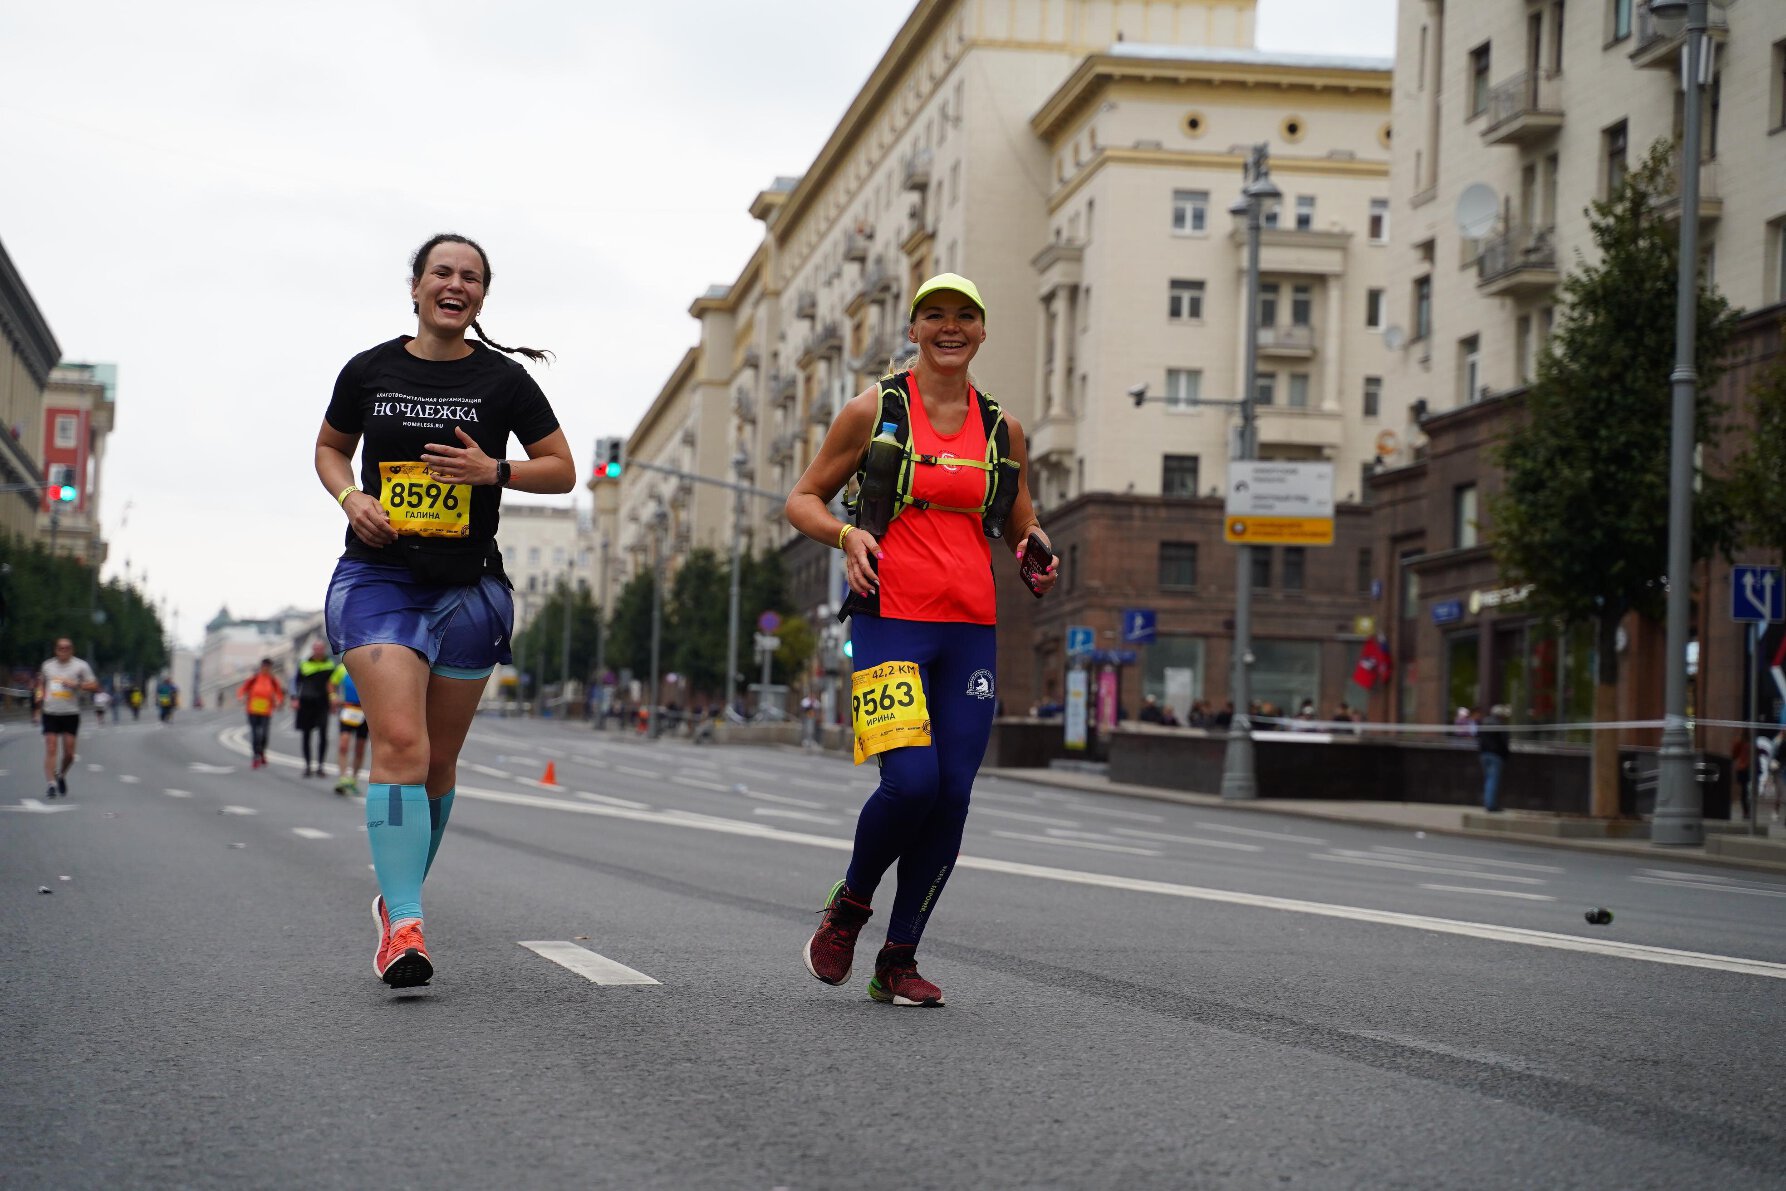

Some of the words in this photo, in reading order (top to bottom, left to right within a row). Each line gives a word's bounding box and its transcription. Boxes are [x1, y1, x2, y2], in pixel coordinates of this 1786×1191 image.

[373, 402, 479, 422] НОЧЛЕЖКА
[402, 421, 444, 429] HOMELESS.RU
[390, 482, 459, 511] 8596
[405, 510, 441, 519] ГАЛИНА
[872, 665, 895, 680] 42,2
[852, 681, 915, 723] 9563
[866, 712, 896, 727] ИРИНА
